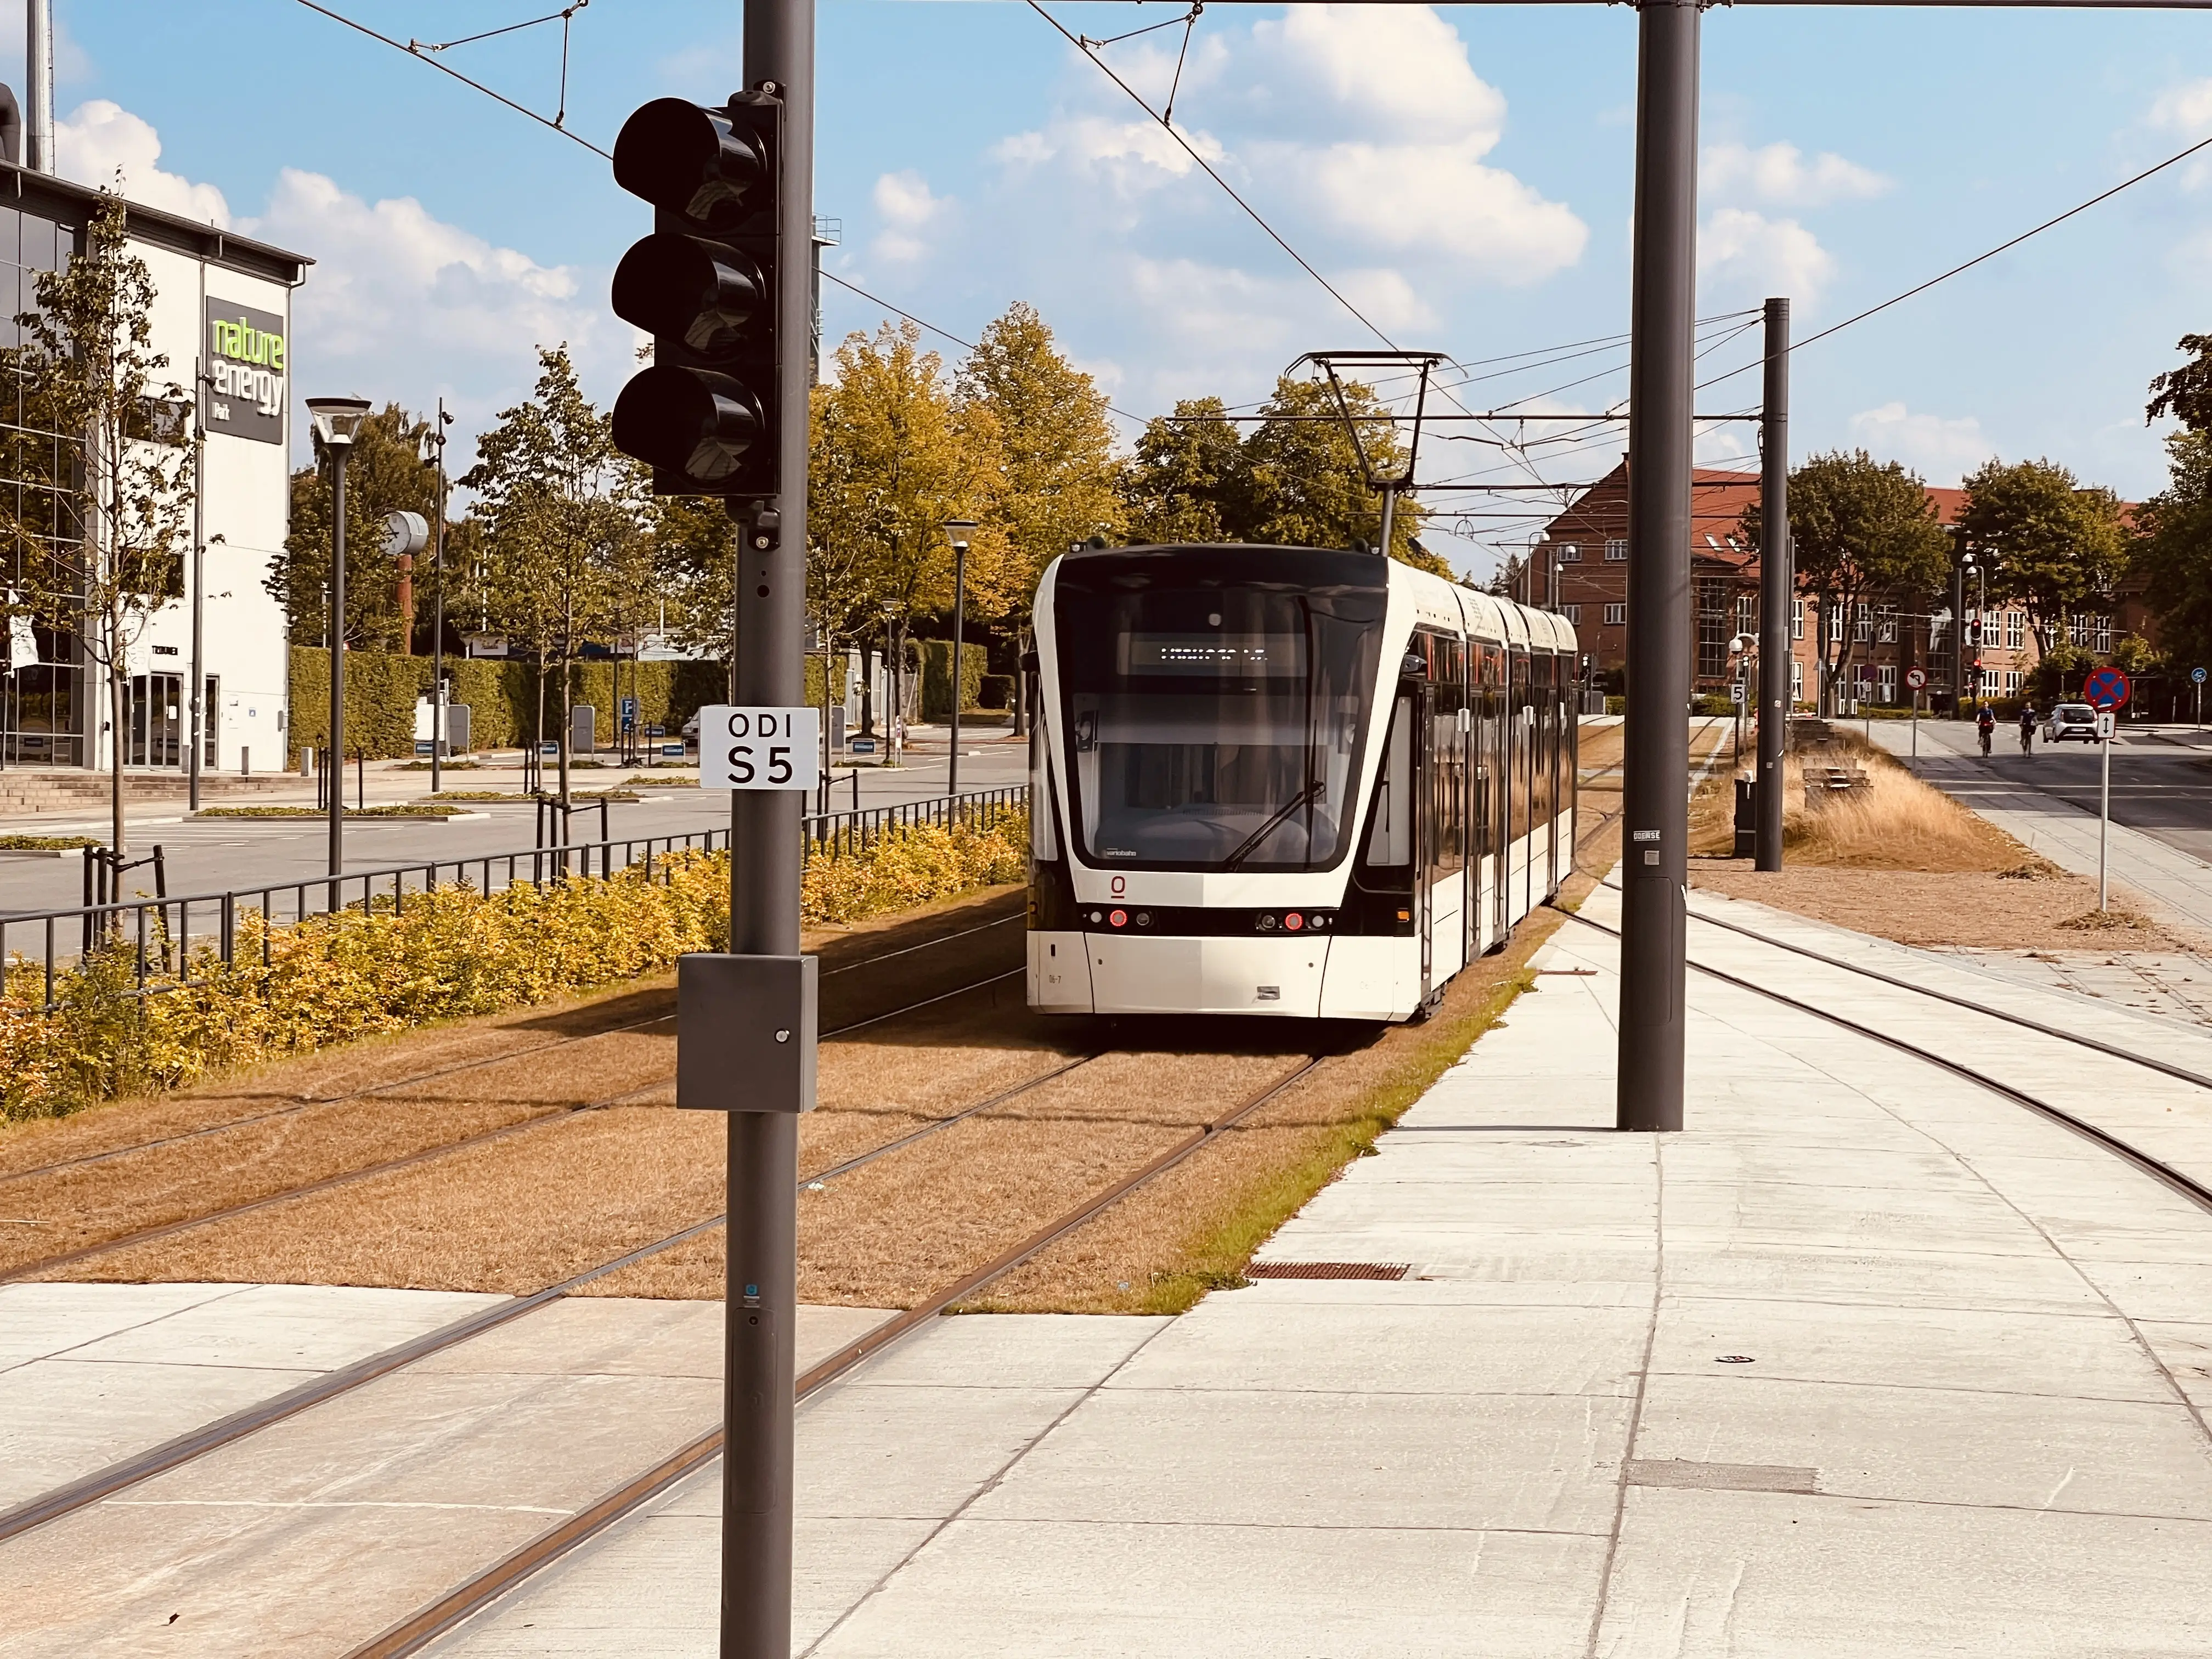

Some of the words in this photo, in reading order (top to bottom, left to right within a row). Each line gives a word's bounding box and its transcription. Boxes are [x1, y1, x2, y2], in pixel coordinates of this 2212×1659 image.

[212, 317, 283, 369] nature
[212, 359, 284, 416] energy
[1734, 686, 1742, 700] 5
[728, 713, 791, 738] ODI
[727, 746, 793, 784] S5
[1633, 832, 1660, 840] ODENSE
